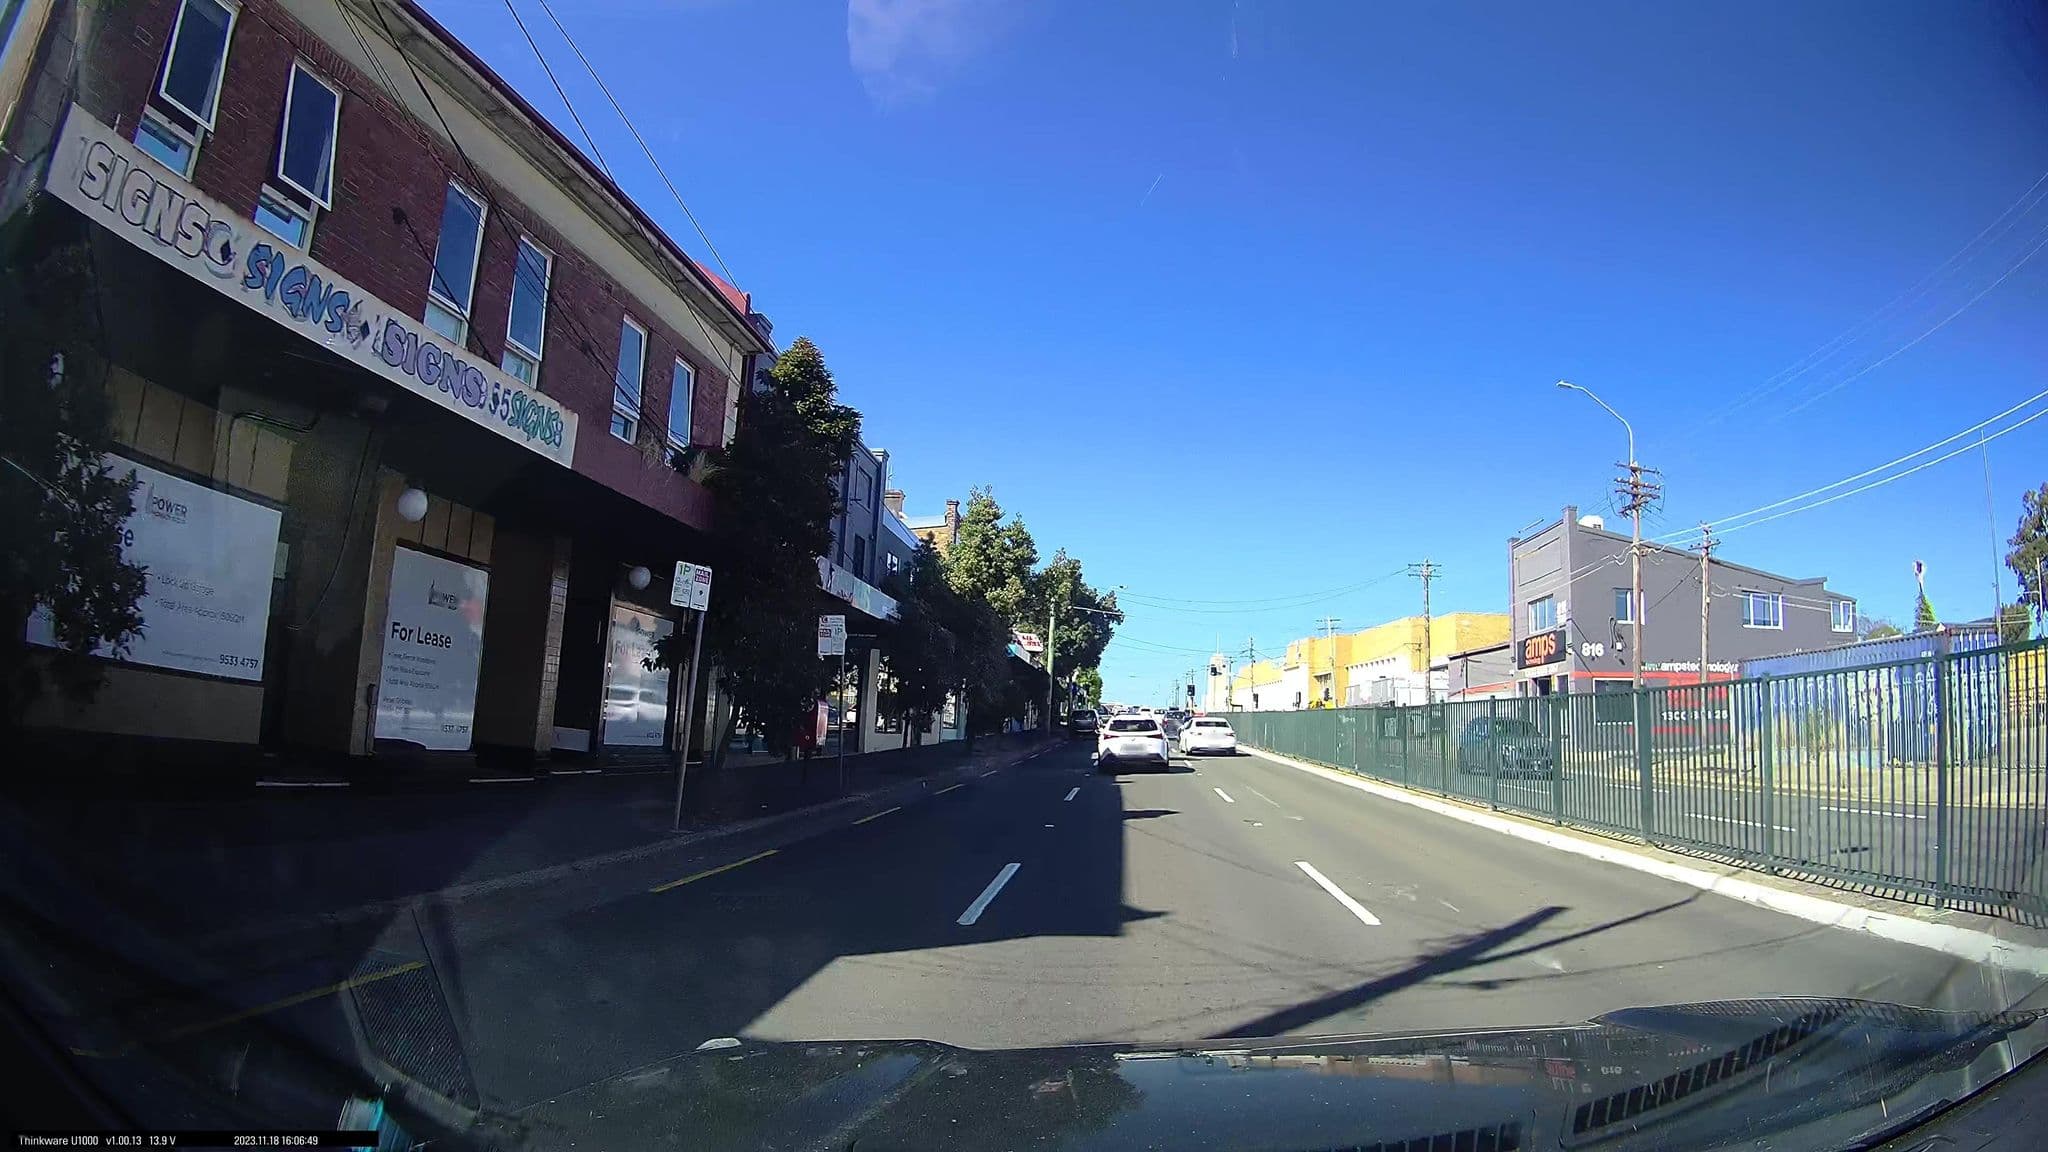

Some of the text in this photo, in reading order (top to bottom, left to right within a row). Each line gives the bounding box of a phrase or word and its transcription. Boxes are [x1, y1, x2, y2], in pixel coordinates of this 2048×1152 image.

[244, 243, 350, 334] SIGNS
[382, 318, 484, 408] SIGNS
[391, 621, 452, 649] For Lease
[1525, 633, 1556, 665] amps
[219, 654, 239, 667] 9533
[1581, 642, 1605, 657] 816
